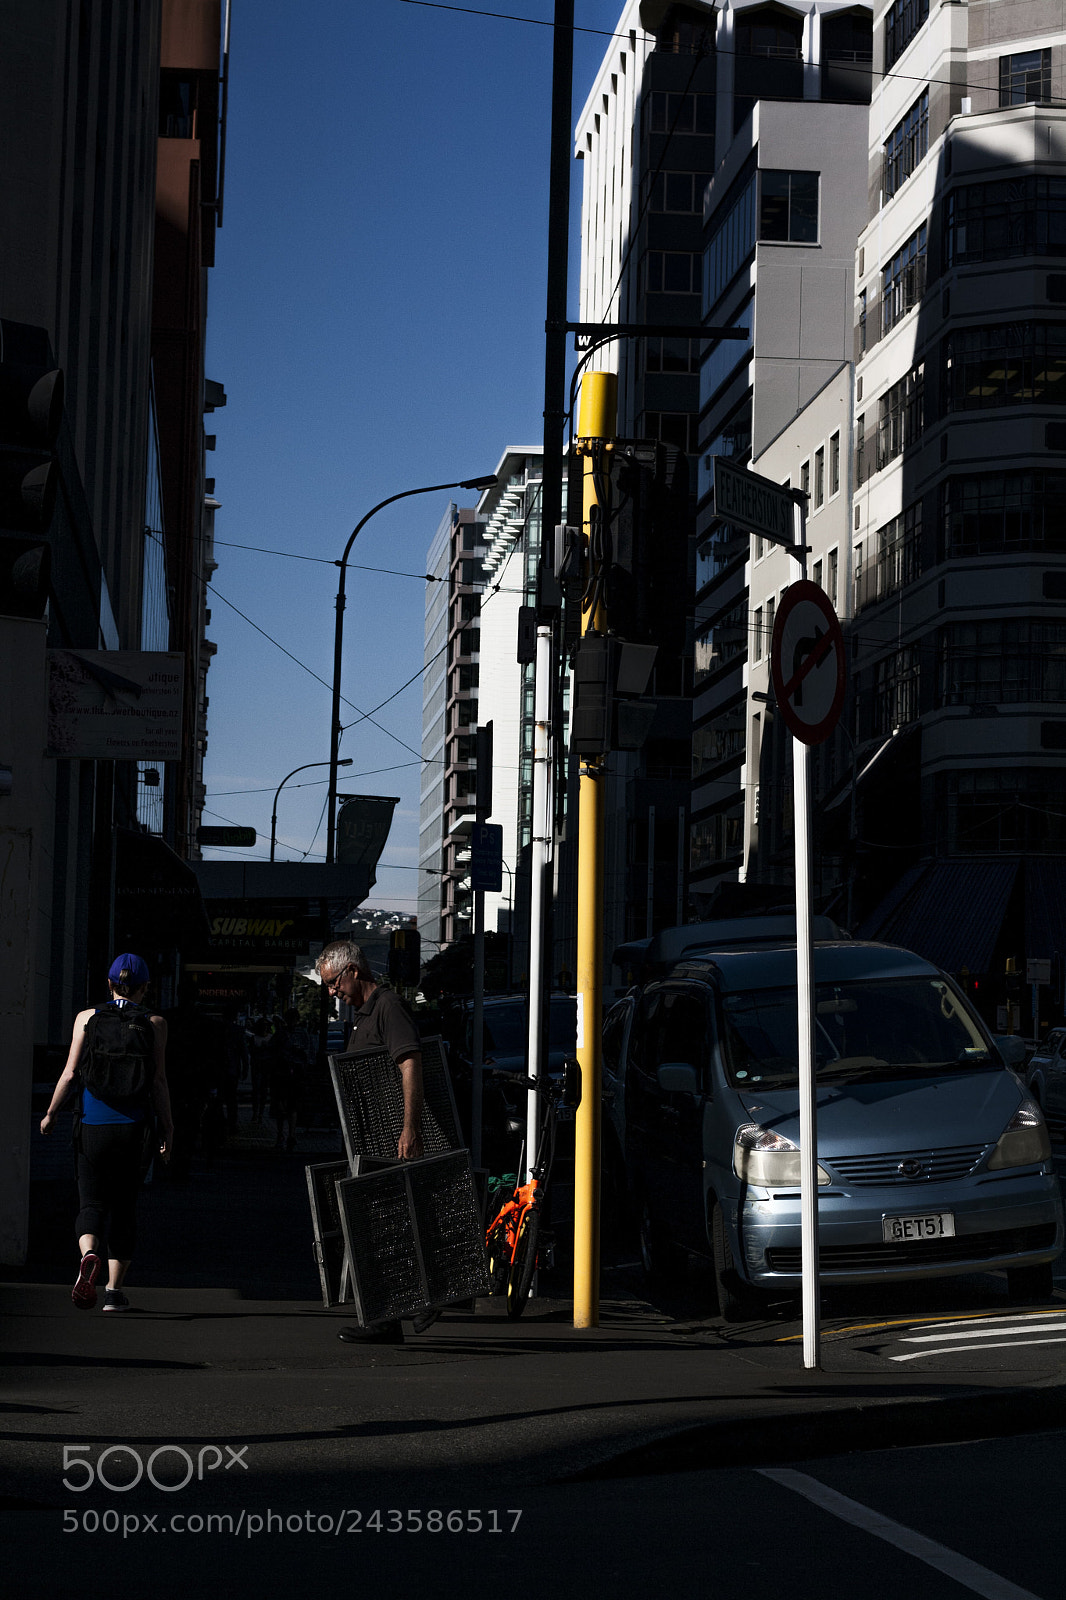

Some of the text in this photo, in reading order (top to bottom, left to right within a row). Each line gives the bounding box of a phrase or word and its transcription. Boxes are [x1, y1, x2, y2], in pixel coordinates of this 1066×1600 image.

[577, 335, 592, 346] W
[720, 470, 790, 534] FEATHERSTON ST
[209, 917, 294, 936] SUBWAY
[264, 938, 304, 949] BARBER
[892, 1217, 945, 1238] GET51
